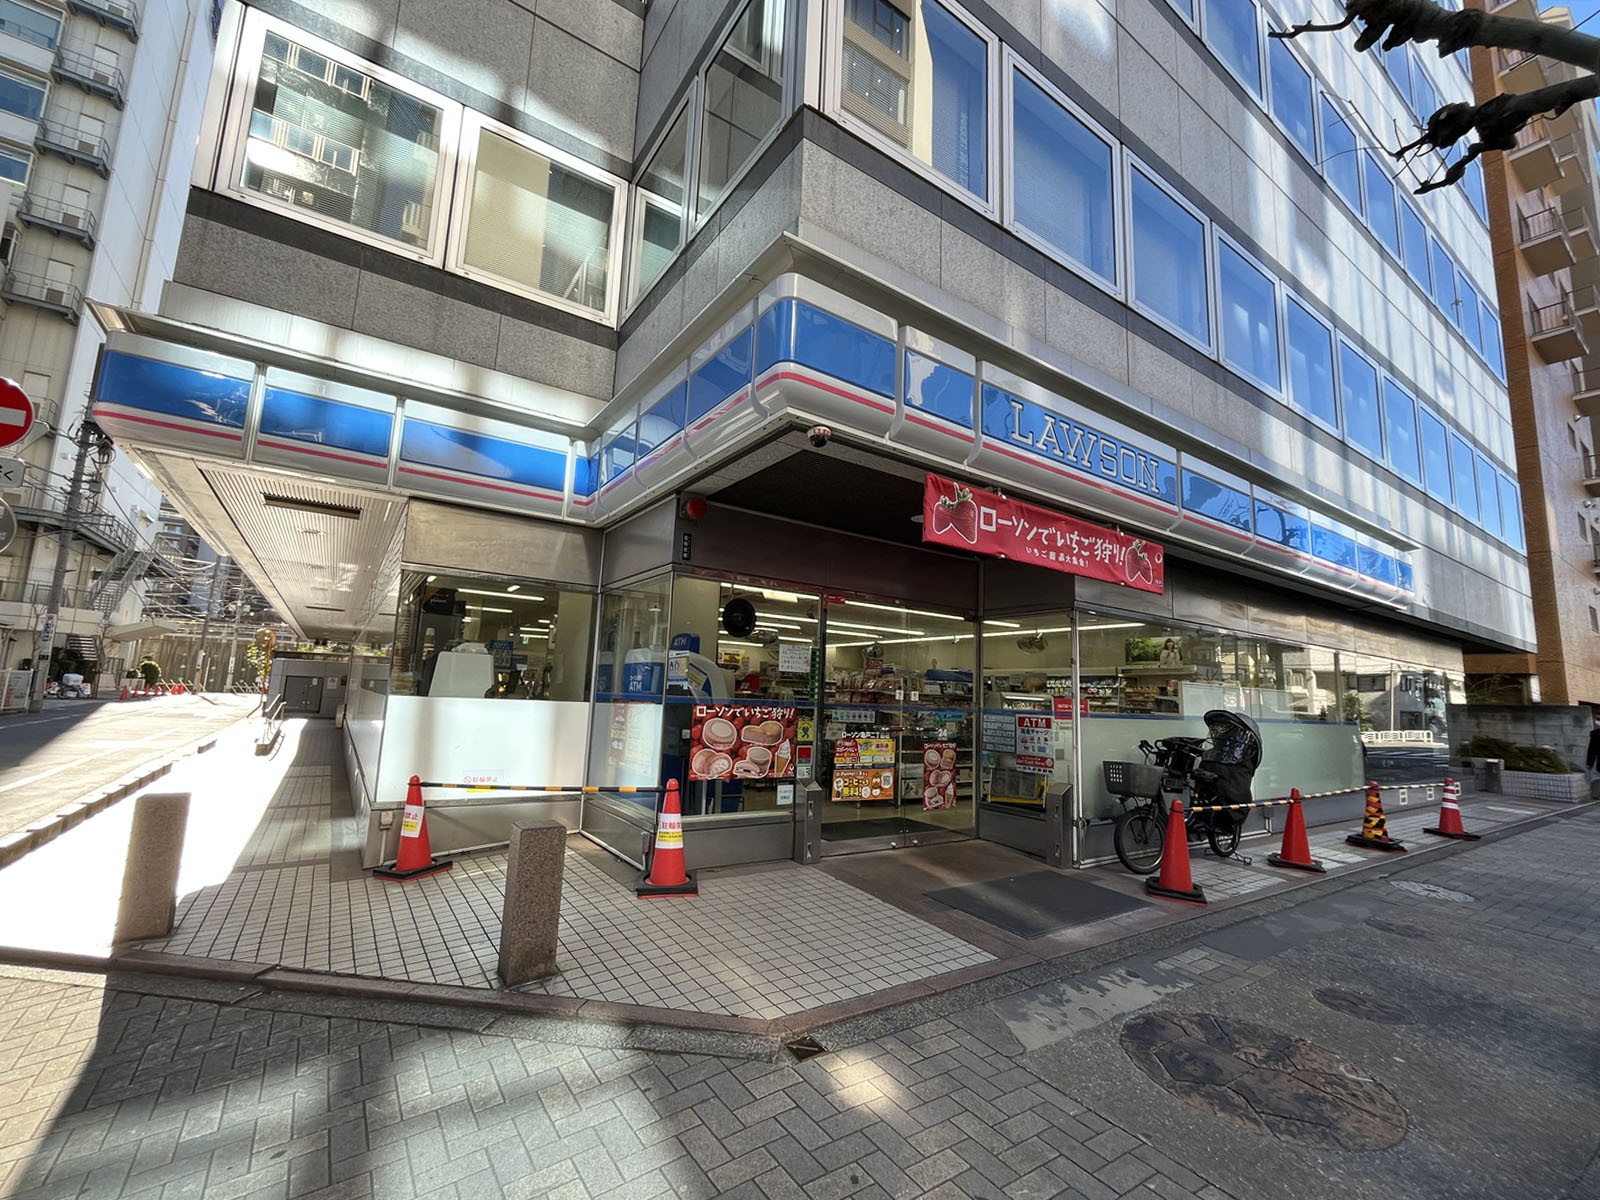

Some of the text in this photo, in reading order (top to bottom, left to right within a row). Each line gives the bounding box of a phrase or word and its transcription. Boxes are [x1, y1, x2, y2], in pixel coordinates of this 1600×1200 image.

[1010, 399, 1160, 495] LAWSON
[980, 505, 1126, 566] ローソンでいちご狩り!
[629, 681, 642, 692] ATM
[696, 705, 795, 720] ローソンでいちご狩り!
[1023, 717, 1047, 728] ATM
